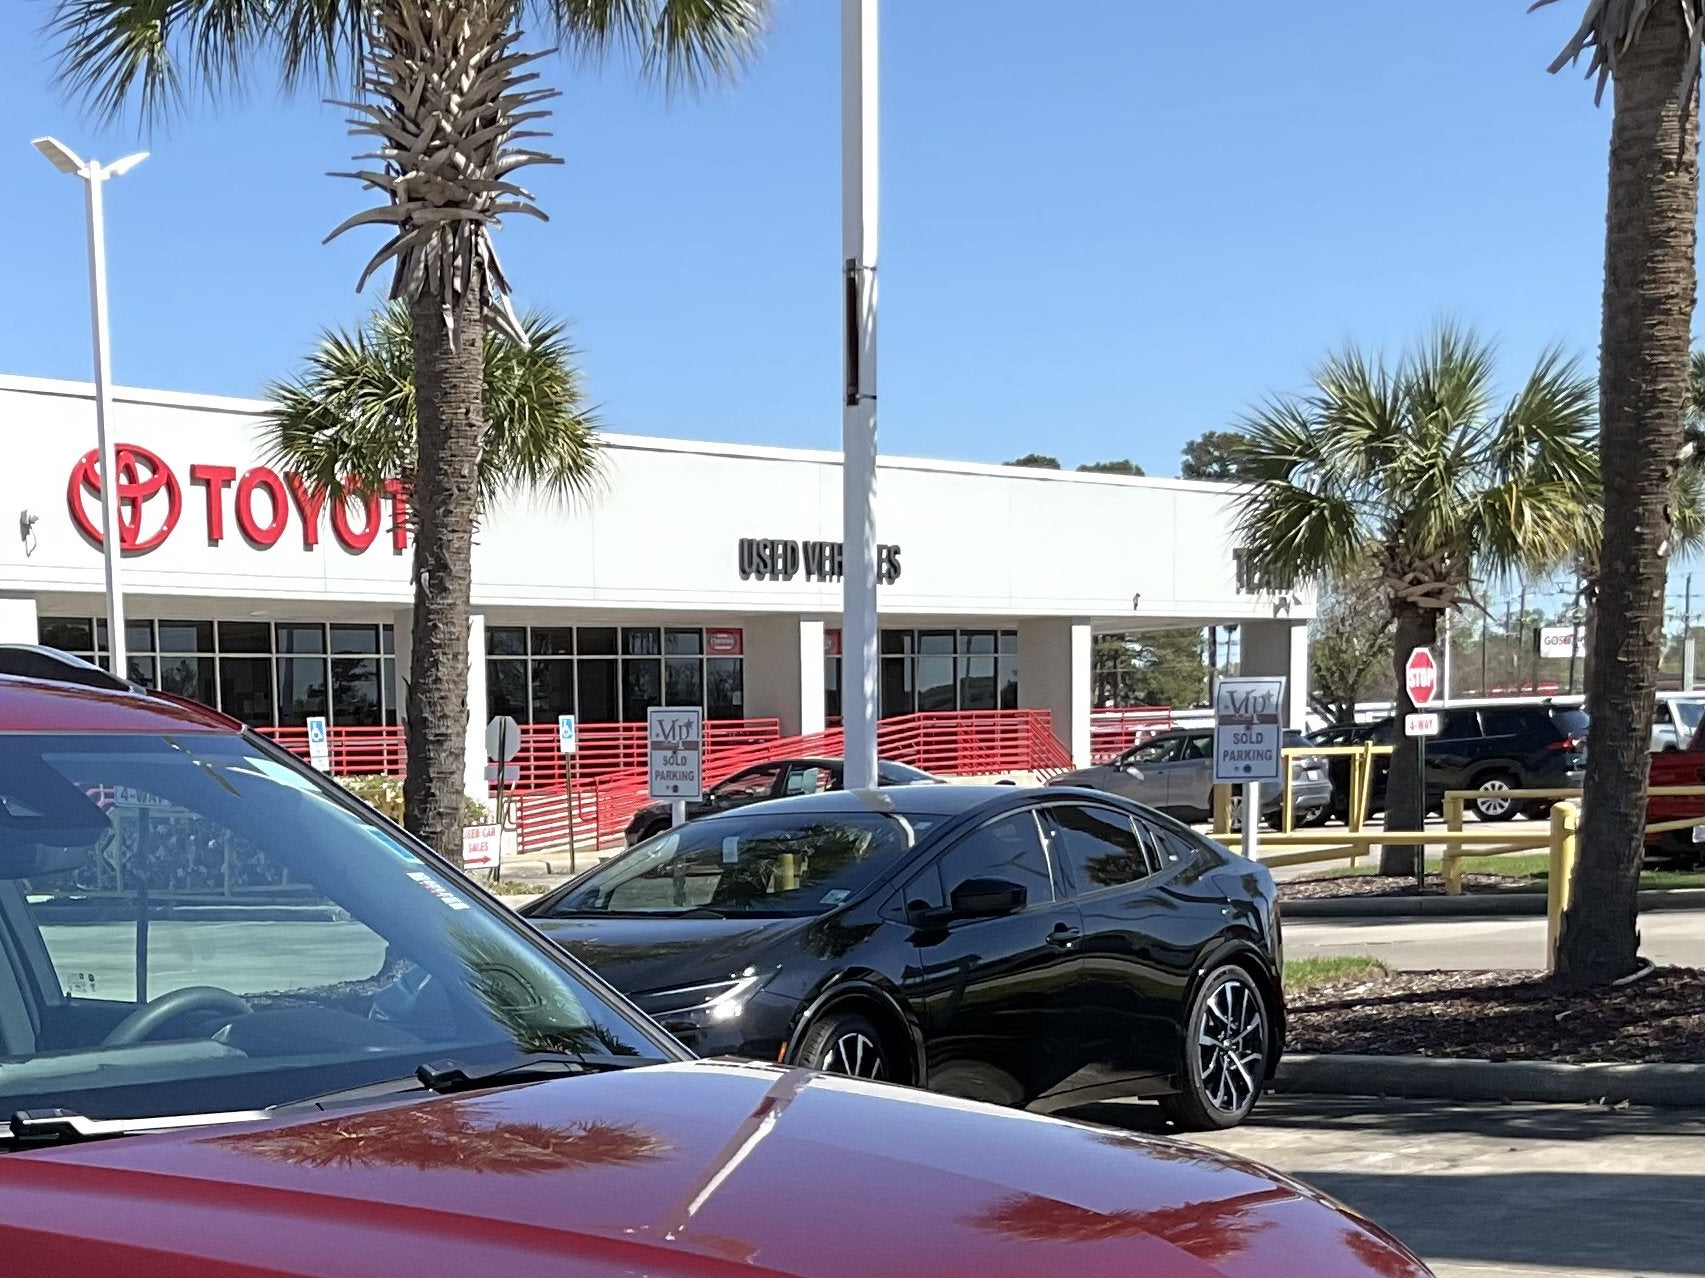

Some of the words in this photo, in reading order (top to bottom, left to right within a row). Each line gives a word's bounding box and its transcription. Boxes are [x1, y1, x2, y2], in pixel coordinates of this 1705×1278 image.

[190, 464, 414, 555] TOYOT
[739, 538, 799, 581] USED
[802, 541, 901, 585] VEHES
[1408, 667, 1434, 688] STOP
[1409, 720, 1433, 730] 4-WAY
[1233, 733, 1263, 744] SOLD
[662, 755, 687, 766] SOLD
[1223, 749, 1272, 761] PARKING
[654, 770, 695, 781] PARKING
[482, 827, 496, 838] CAR
[469, 842, 489, 853] SALES
